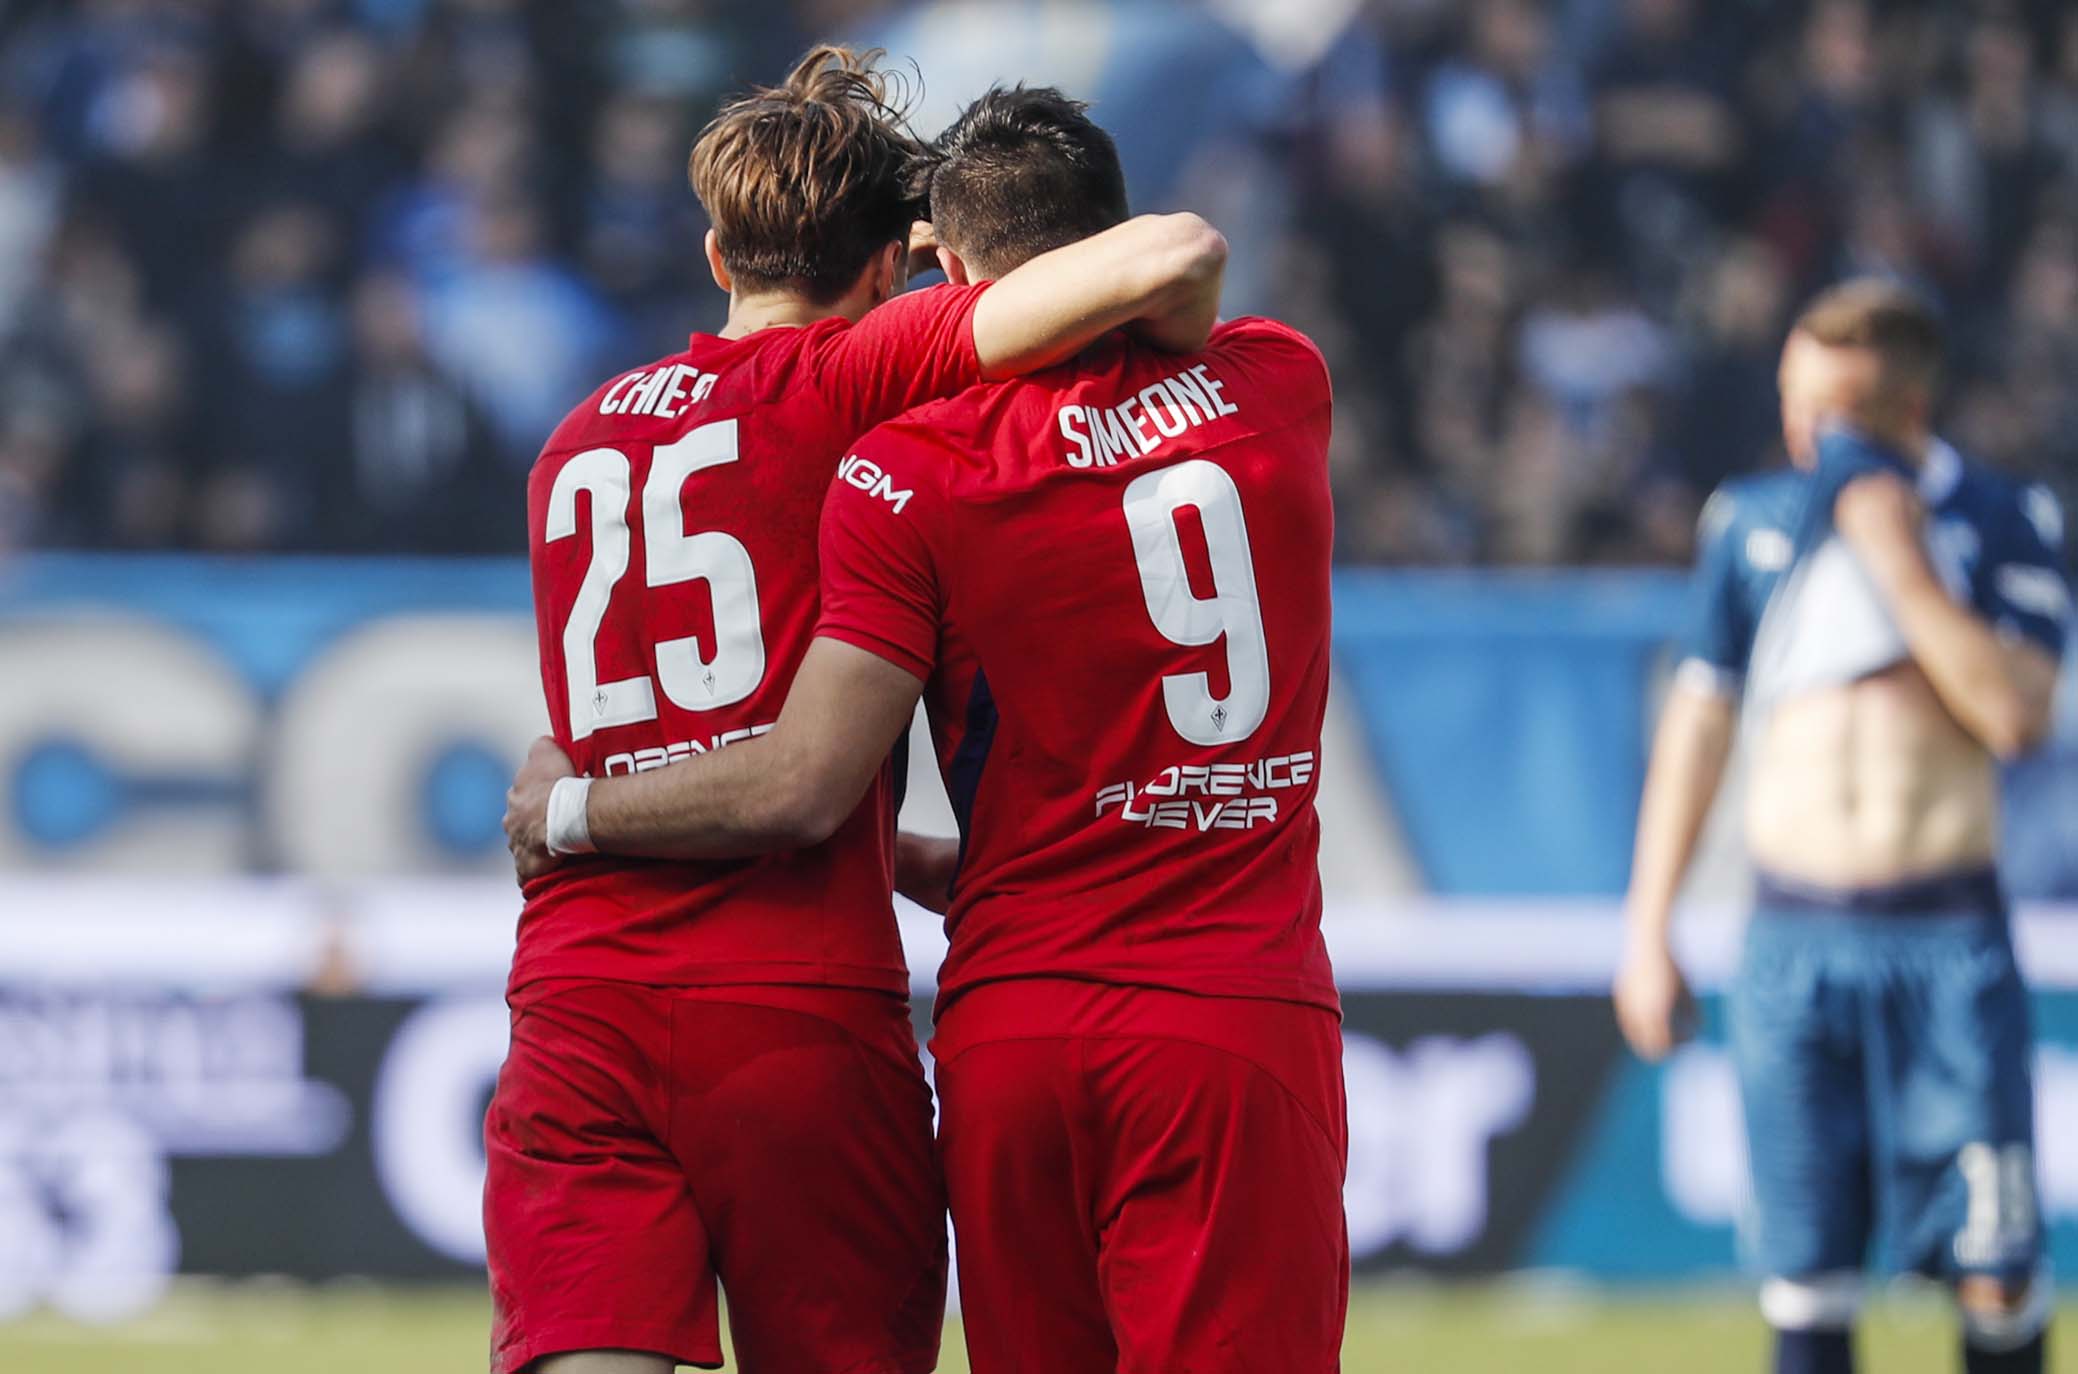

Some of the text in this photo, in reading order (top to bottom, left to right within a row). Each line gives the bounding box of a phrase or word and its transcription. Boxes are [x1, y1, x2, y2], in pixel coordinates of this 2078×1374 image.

[599, 363, 719, 419] CHIES
[1058, 363, 1239, 469] SIMEONE
[545, 418, 767, 743] 25
[1122, 459, 1271, 747] 9
[1095, 750, 1314, 817] FLORENCE
